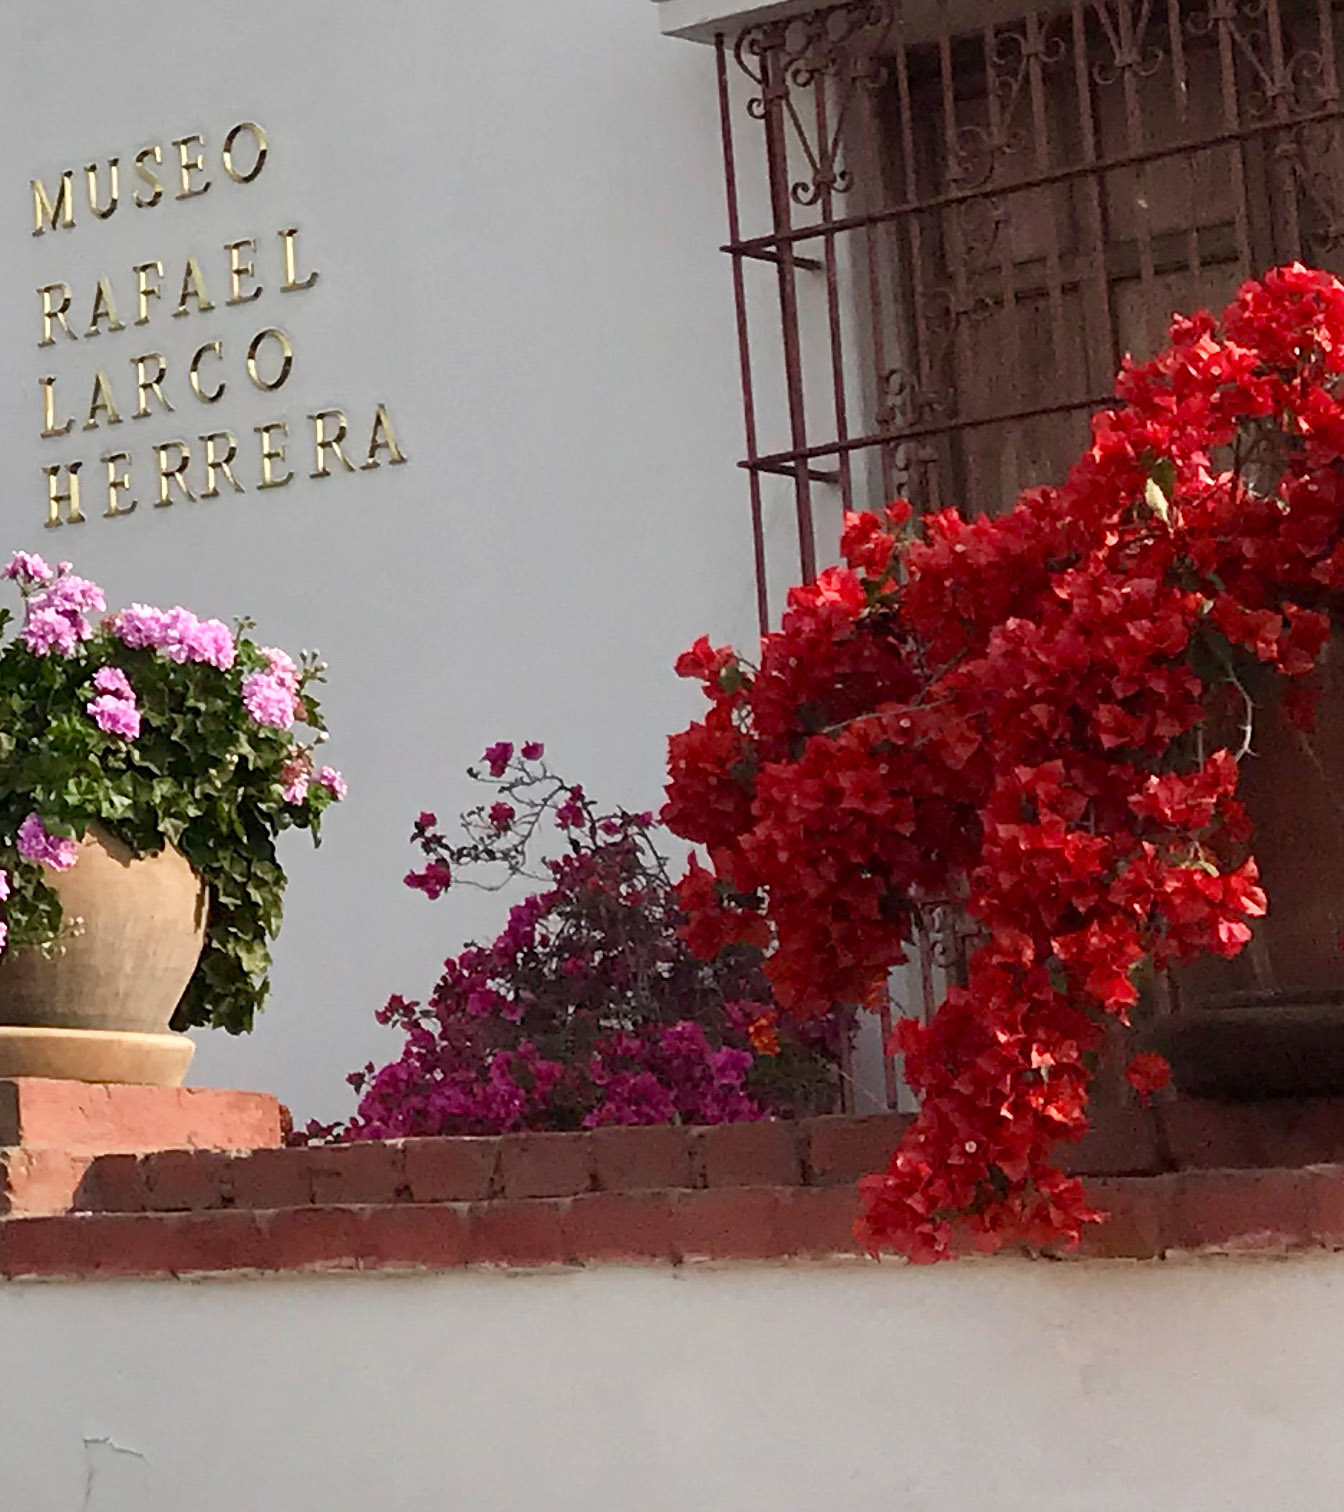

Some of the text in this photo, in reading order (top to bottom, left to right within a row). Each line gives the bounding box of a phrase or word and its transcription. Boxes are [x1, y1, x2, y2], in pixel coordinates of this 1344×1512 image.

[30, 121, 268, 236] MUSEO
[37, 227, 319, 347] RAFAEL
[39, 327, 293, 438] LARCO
[42, 404, 408, 528] HERRERA
